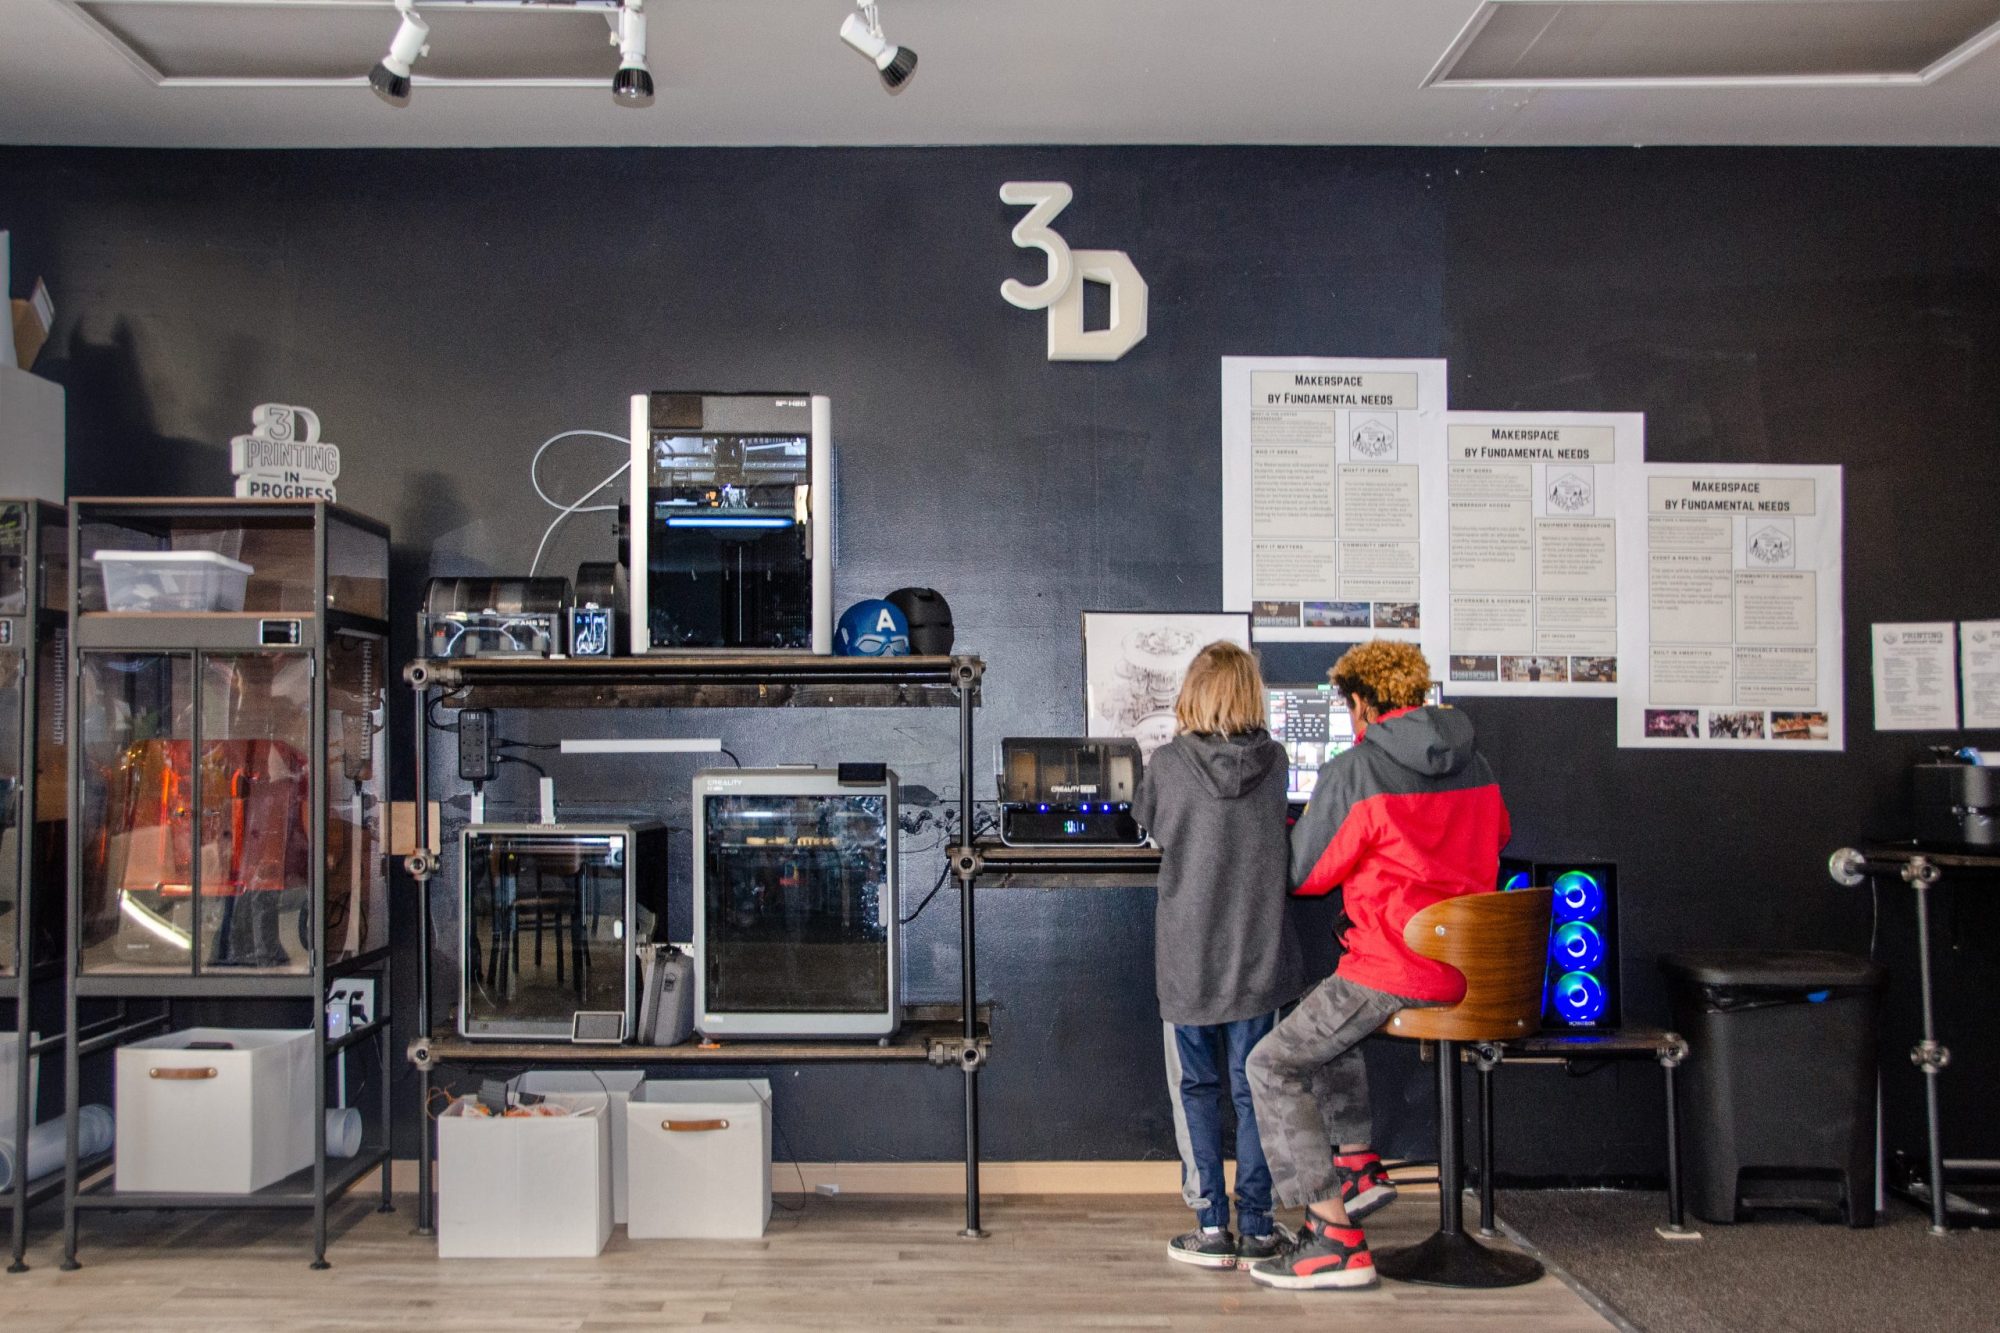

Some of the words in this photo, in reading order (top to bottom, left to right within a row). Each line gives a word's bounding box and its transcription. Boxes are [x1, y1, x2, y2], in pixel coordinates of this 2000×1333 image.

[1000, 181, 1149, 361] 3D
[246, 438, 338, 476] PRINTING
[284, 471, 300, 482] IN
[250, 481, 333, 503] PROGRESS
[876, 608, 897, 632] A
